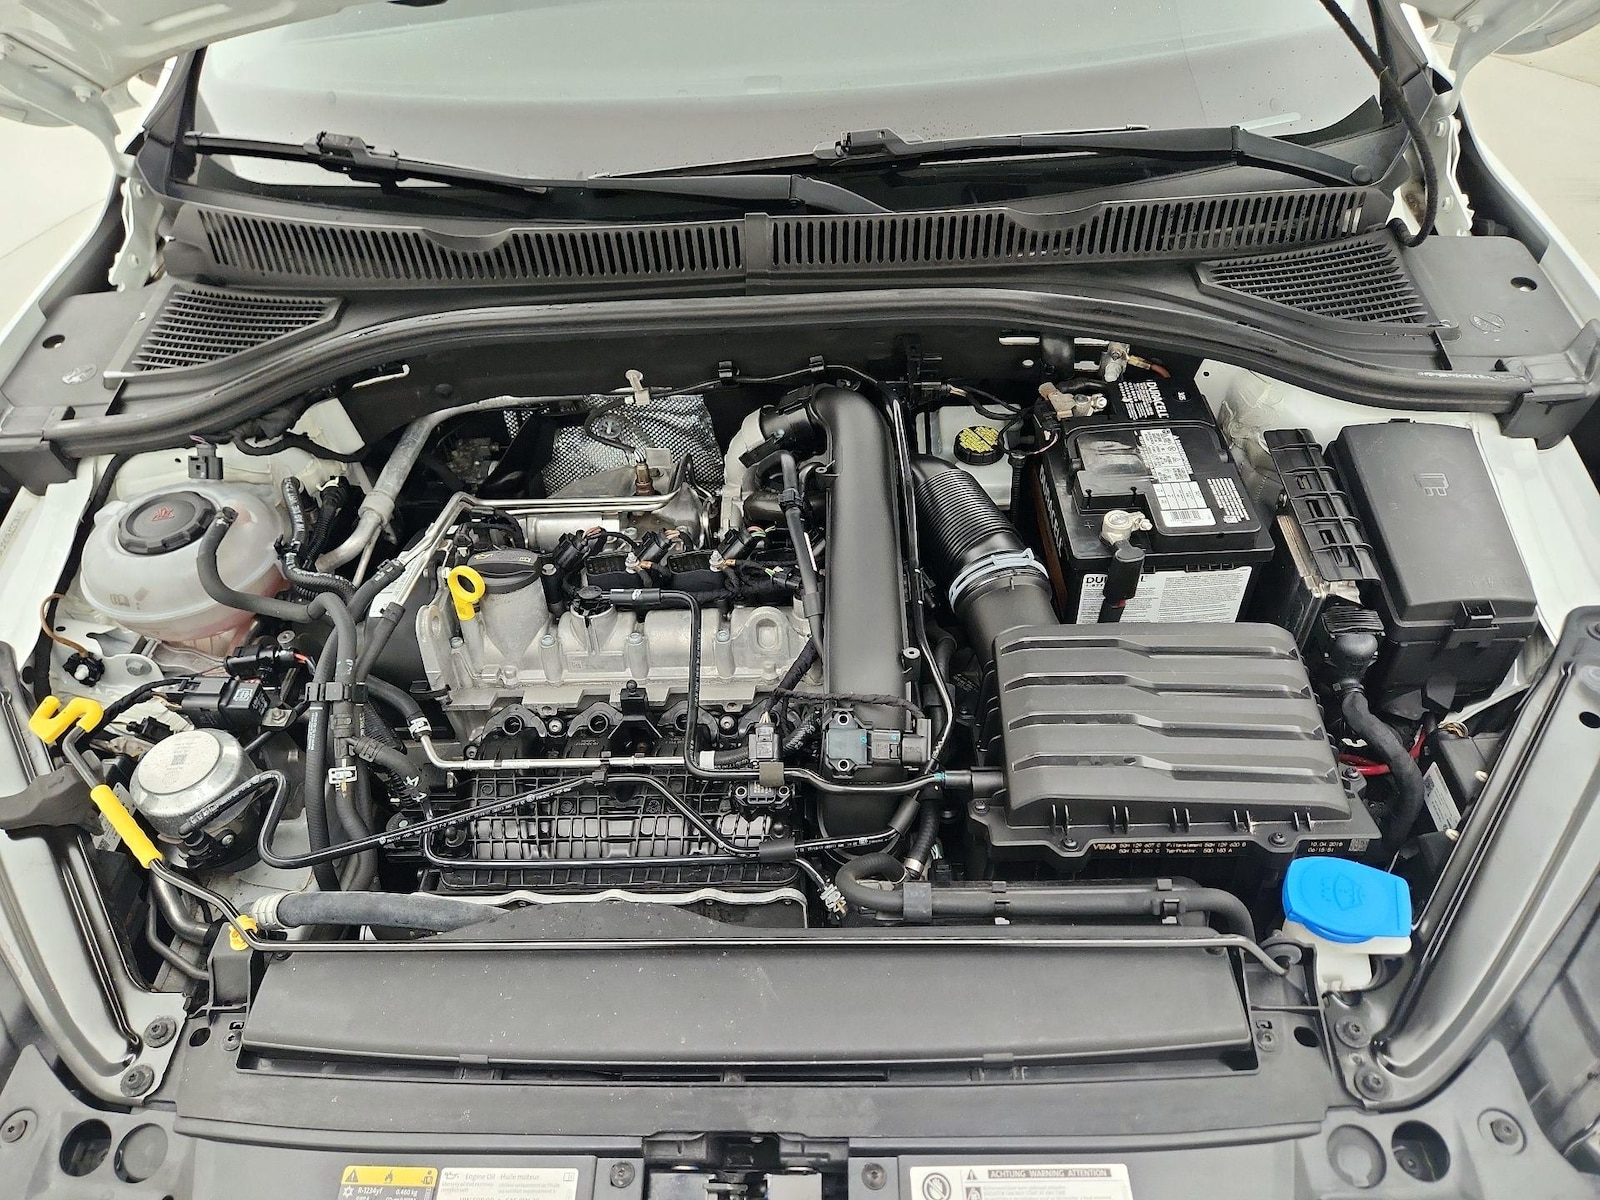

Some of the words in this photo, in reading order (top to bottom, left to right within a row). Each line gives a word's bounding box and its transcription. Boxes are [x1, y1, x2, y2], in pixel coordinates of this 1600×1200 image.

[1146, 381, 1170, 418] DURACELL
[465, 1172, 486, 1181] Engine
[486, 1172, 496, 1180] Oil
[990, 1170, 1026, 1178] ACHTUNG
[1028, 1169, 1065, 1178] WARNING
[1067, 1168, 1107, 1177] ATTENTION
[357, 1187, 384, 1195] R-1234yf
